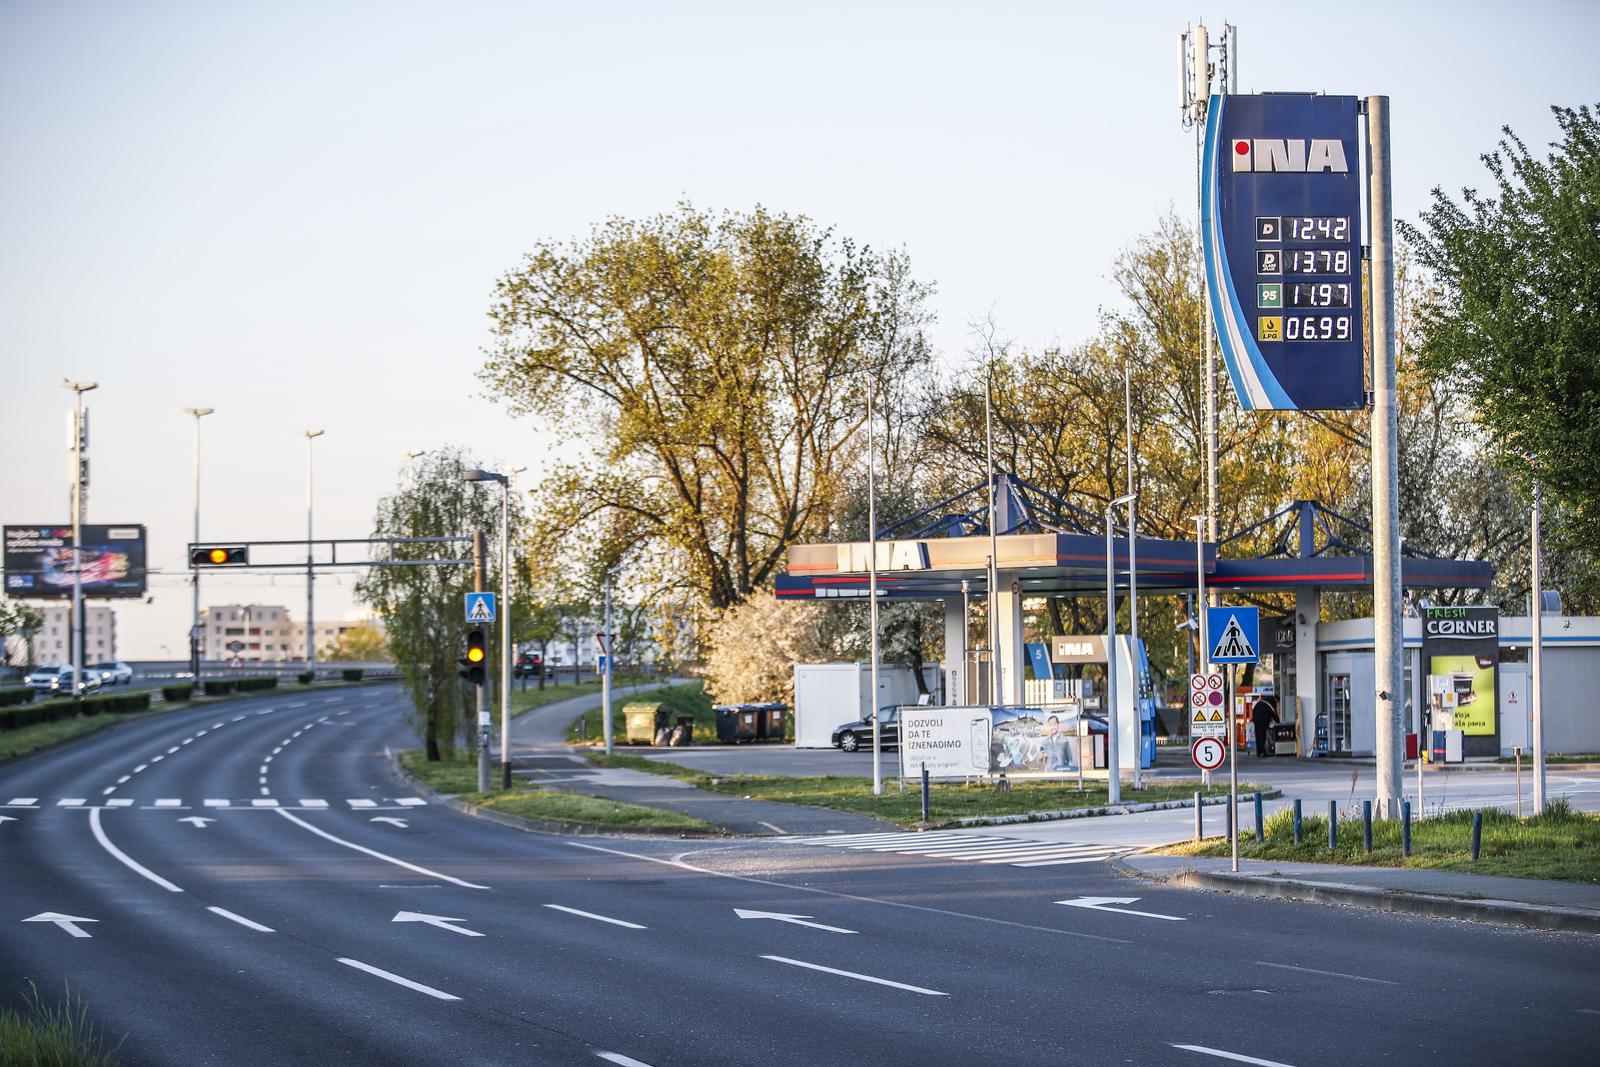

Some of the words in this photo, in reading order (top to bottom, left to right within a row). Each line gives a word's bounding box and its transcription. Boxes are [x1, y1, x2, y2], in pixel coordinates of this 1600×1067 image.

[1263, 224, 1273, 234] D
[1293, 218, 1346, 240] 12.42
[1264, 254, 1275, 263] D
[1293, 251, 1347, 273] 13.78
[1262, 291, 1277, 301] 95
[1294, 284, 1348, 306] 11.97
[1286, 317, 1349, 339] 06.99
[1427, 609, 1466, 618] FRESH
[1427, 621, 1496, 634] CORNER
[1035, 649, 1042, 660] 5
[908, 719, 943, 728] DOZVOLI
[908, 731, 920, 739] DA
[908, 740, 962, 750] IZNENADIMO
[1204, 746, 1213, 762] 5
